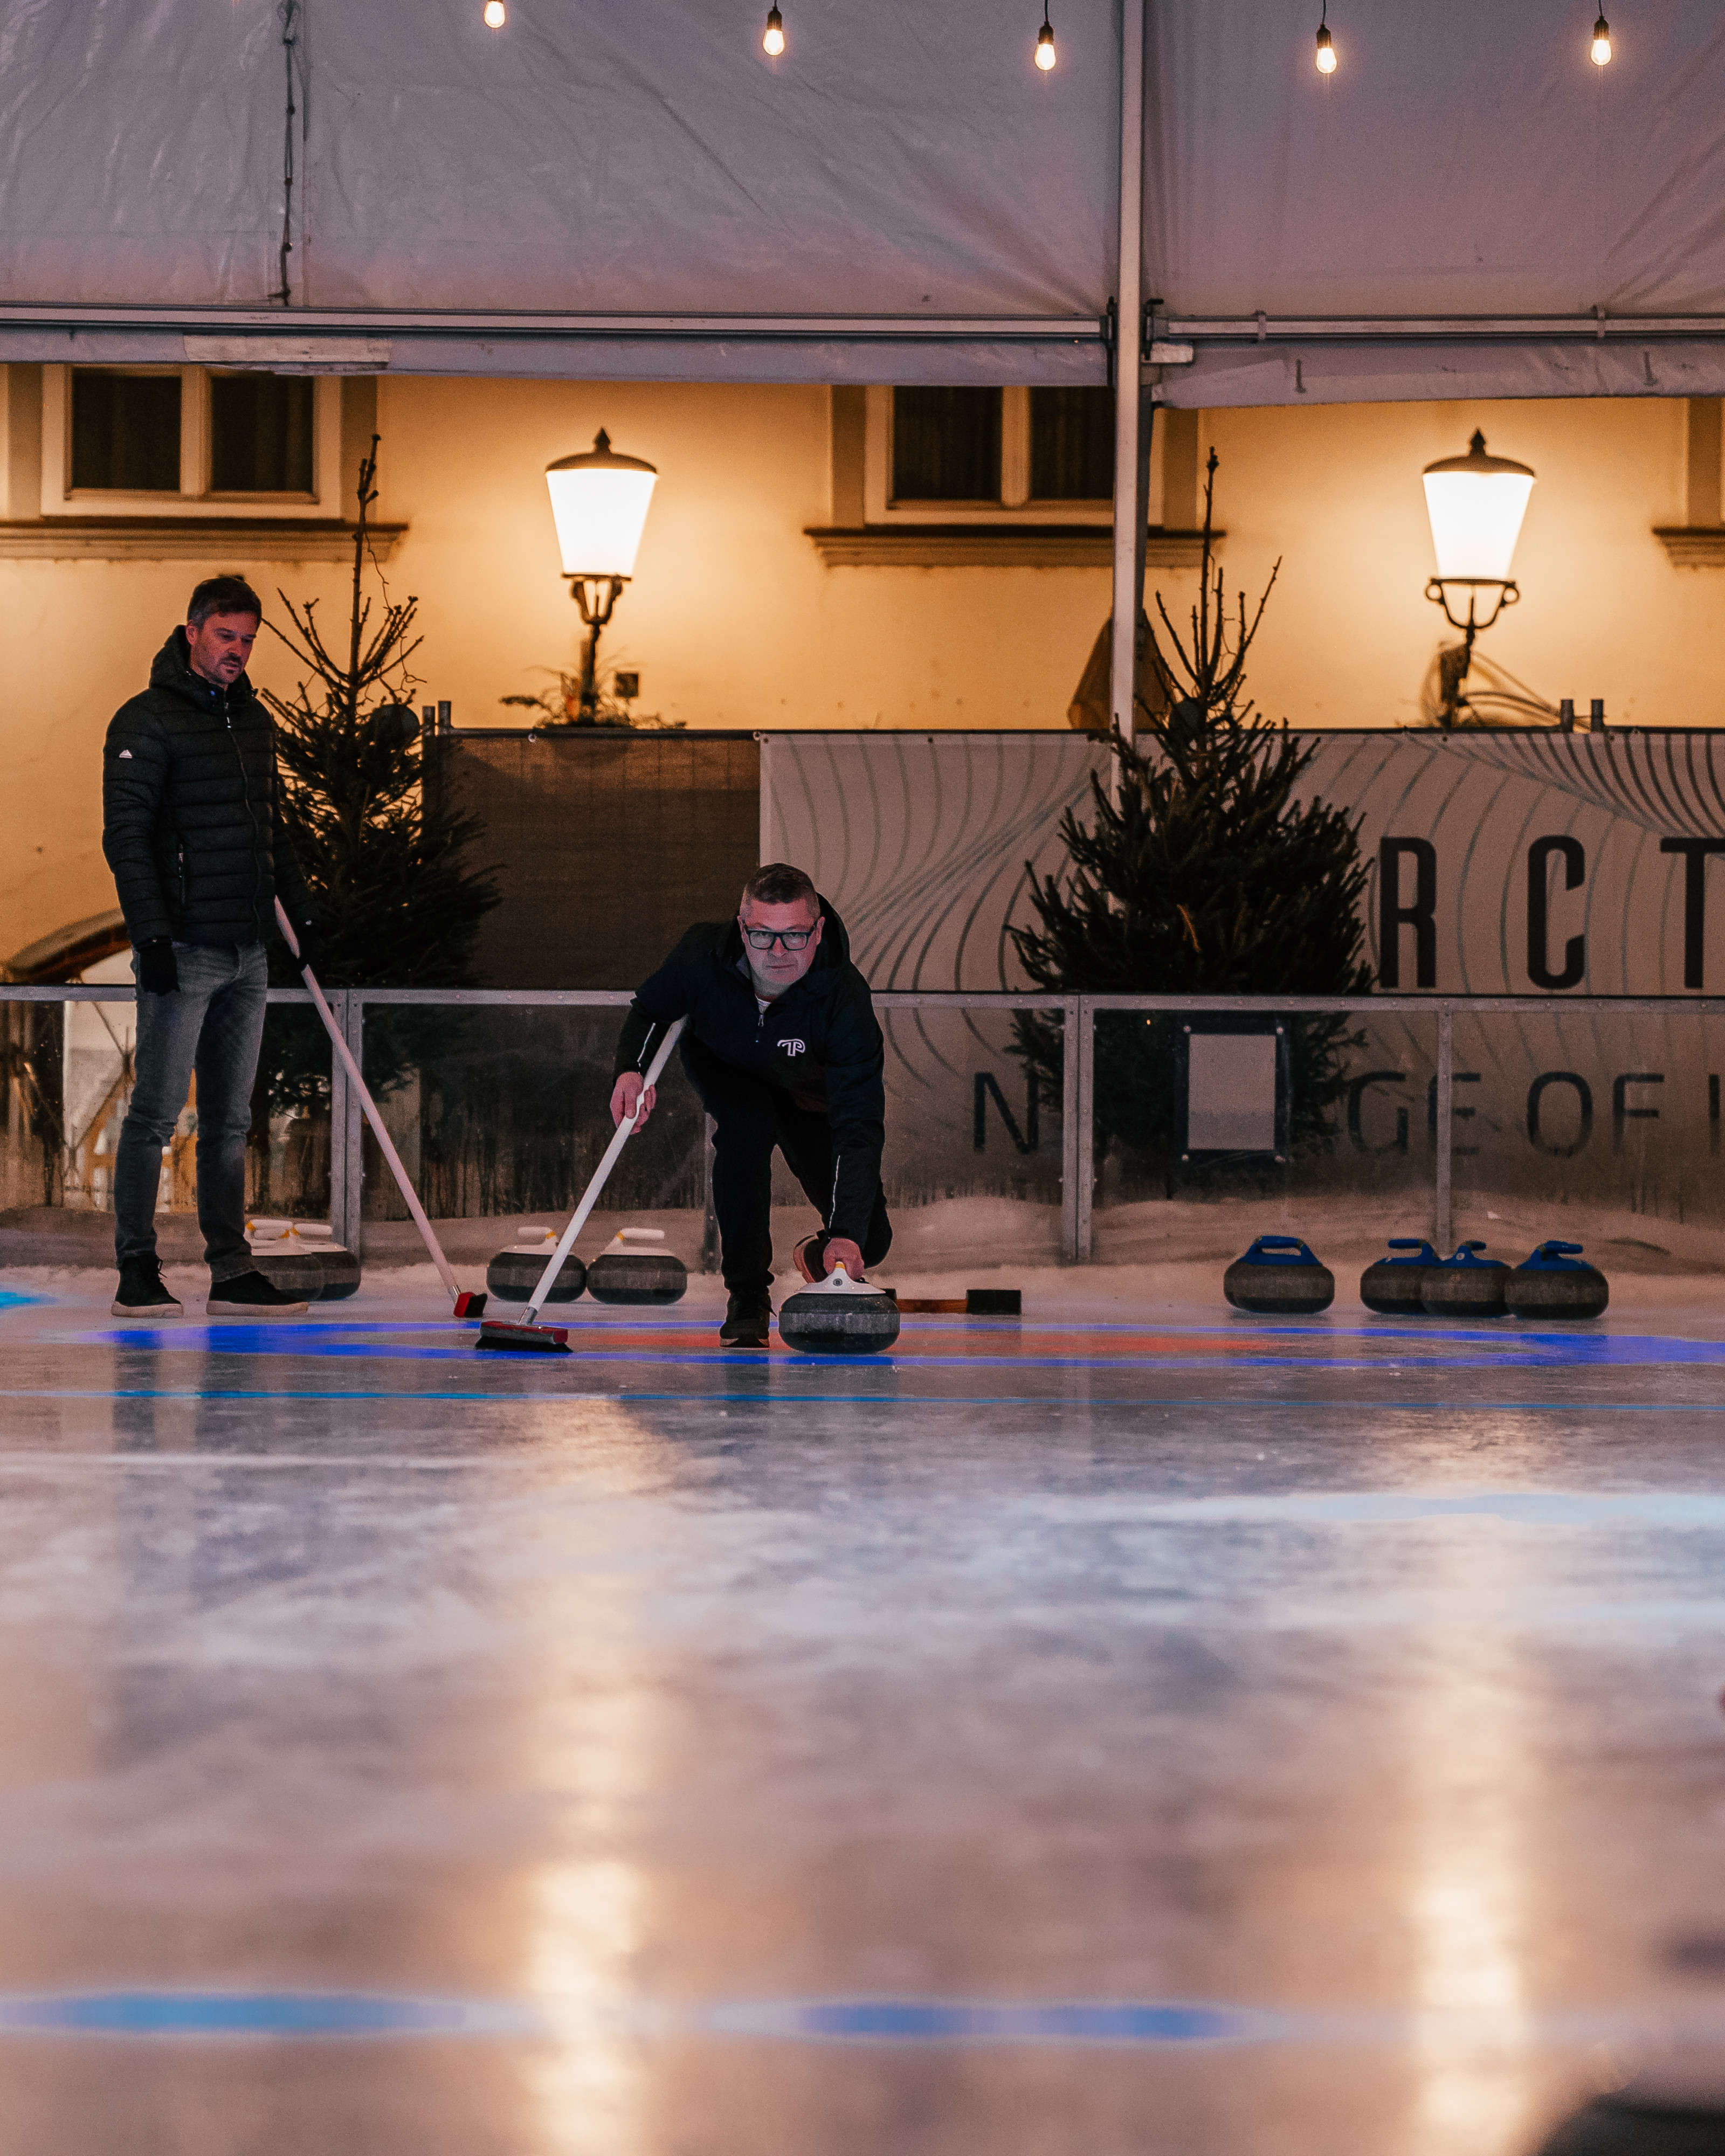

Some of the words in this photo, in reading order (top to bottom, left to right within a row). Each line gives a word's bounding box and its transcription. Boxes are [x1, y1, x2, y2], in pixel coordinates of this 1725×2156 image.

[1379, 835, 1725, 989] RCT
[1348, 1071, 1481, 1155] GE
[1527, 1072, 1665, 1158] OF
